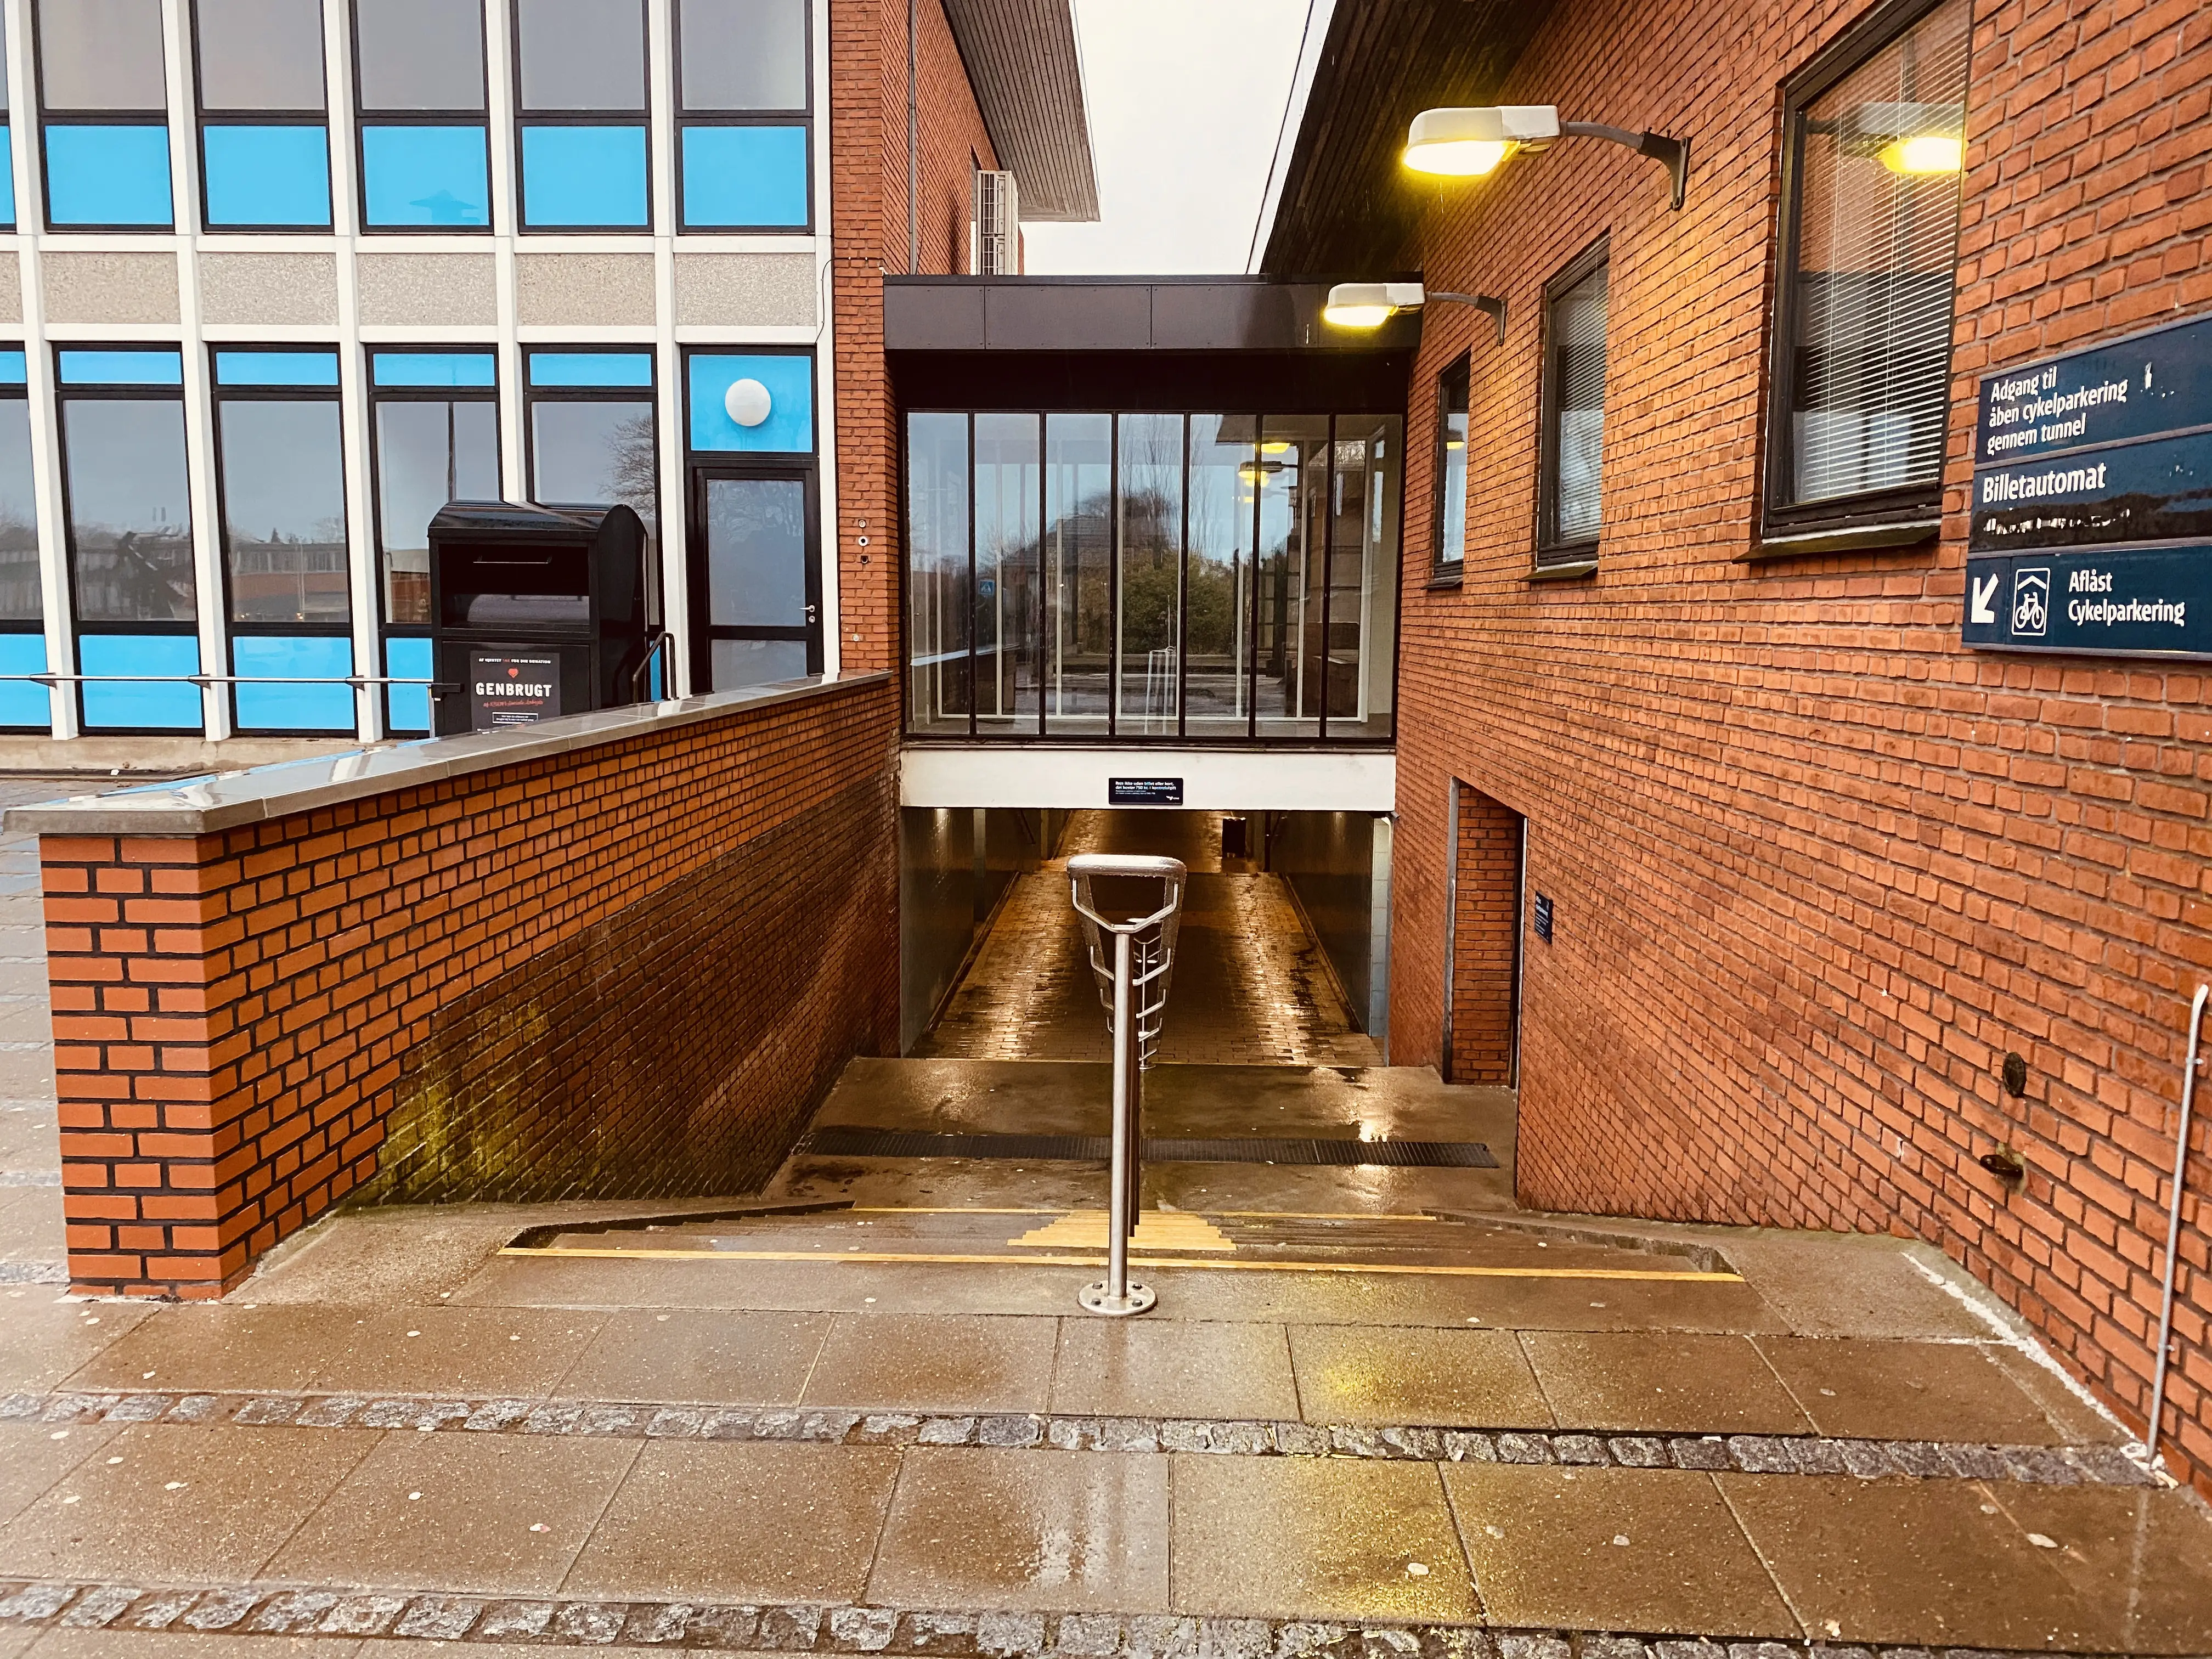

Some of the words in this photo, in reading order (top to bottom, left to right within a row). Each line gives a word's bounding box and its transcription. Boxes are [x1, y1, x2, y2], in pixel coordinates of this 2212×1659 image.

[1990, 374, 2040, 403] Adgang
[2042, 365, 2057, 390] til
[1989, 407, 2019, 428] åben
[2023, 379, 2128, 424] cykelparkering
[1987, 428, 2037, 456] gennem
[2041, 412, 2086, 442] tunnel
[1983, 462, 2107, 503] Billetautomat
[2068, 568, 2112, 593] Aflåst
[2068, 599, 2185, 627] Cykelparkering
[476, 682, 552, 697] GENBRUGT
